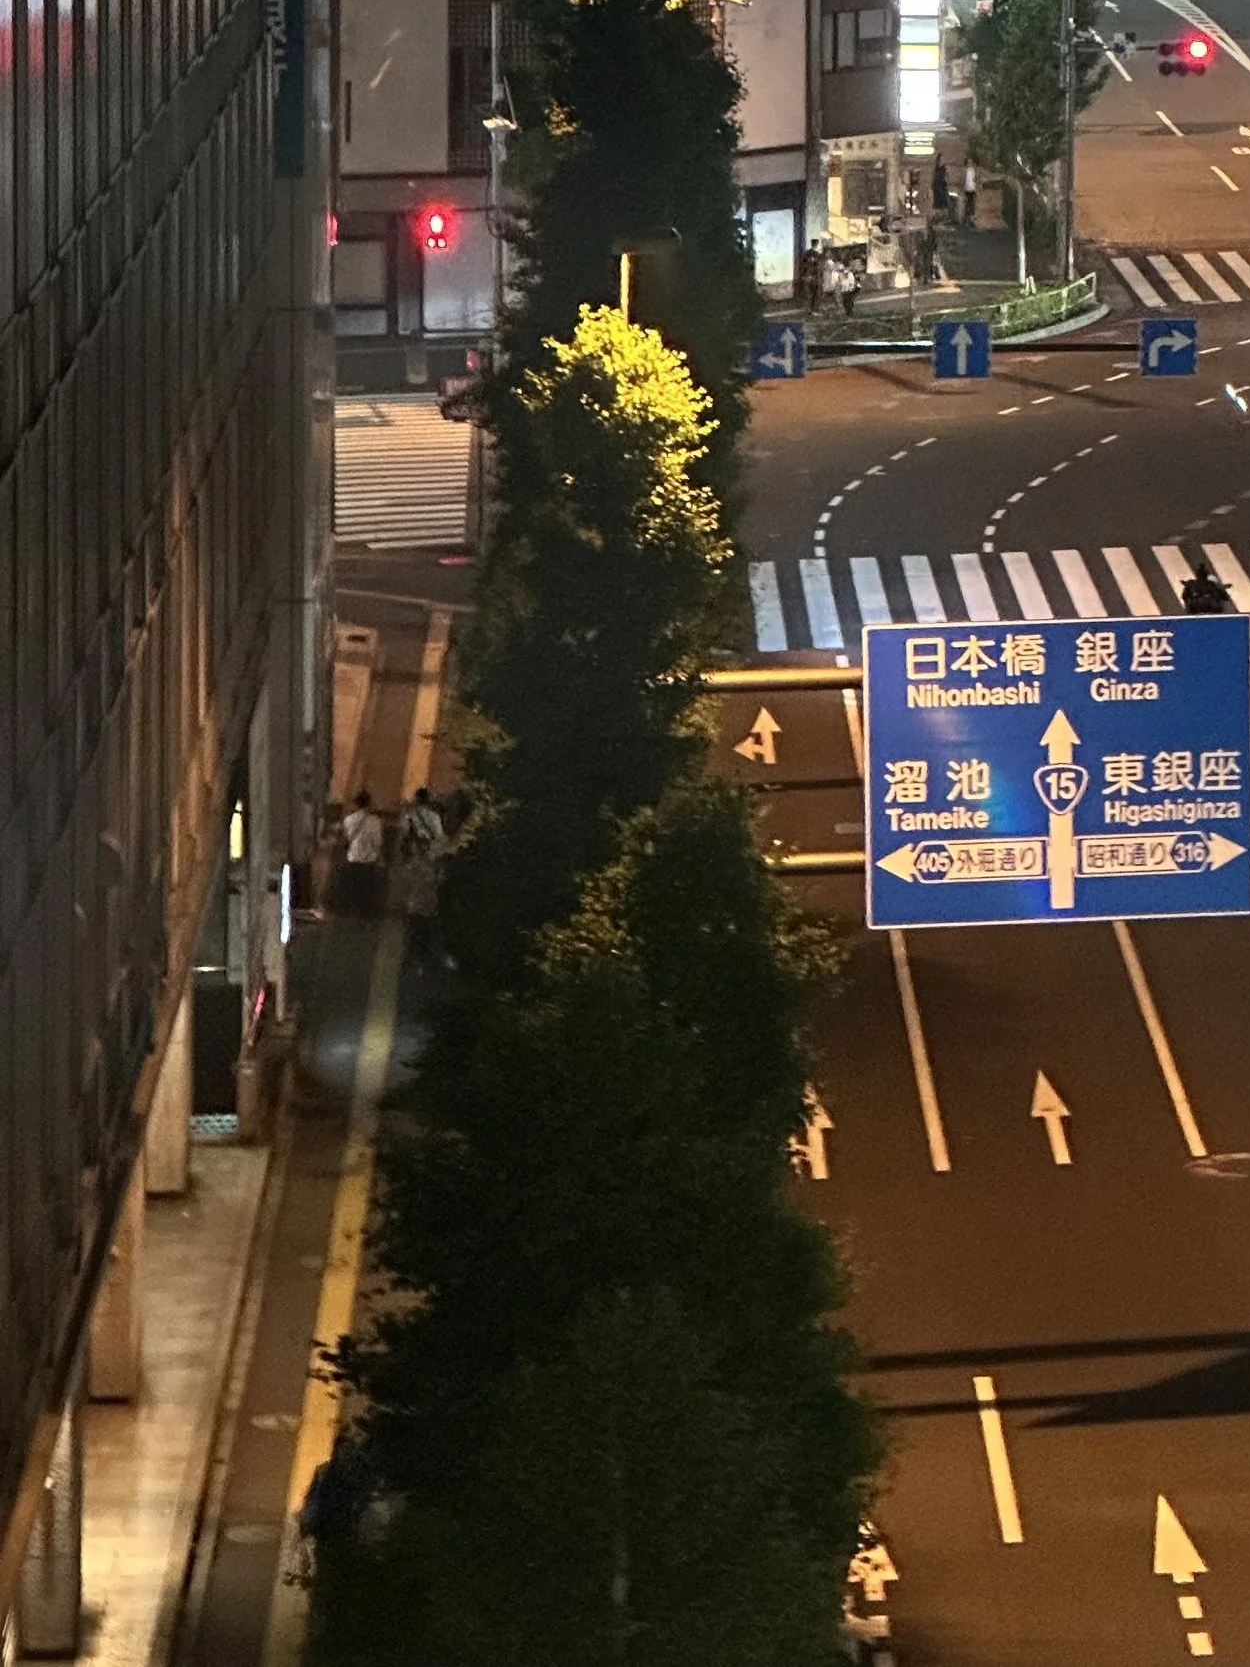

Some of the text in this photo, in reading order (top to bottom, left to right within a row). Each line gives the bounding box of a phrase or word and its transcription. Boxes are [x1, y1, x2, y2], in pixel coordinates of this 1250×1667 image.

[906, 630, 1175, 680] 日本橋 銀座
[907, 677, 1160, 709] Nihonbashi Ginza
[884, 758, 992, 804] 溜池
[1048, 774, 1076, 800] 15
[1102, 749, 1243, 797] 東銀座
[886, 807, 990, 832] Tameike
[1104, 798, 1242, 827] Higashiginza
[915, 847, 1038, 873] 405 外堀通り
[1086, 842, 1206, 868] 昭和通り 316
